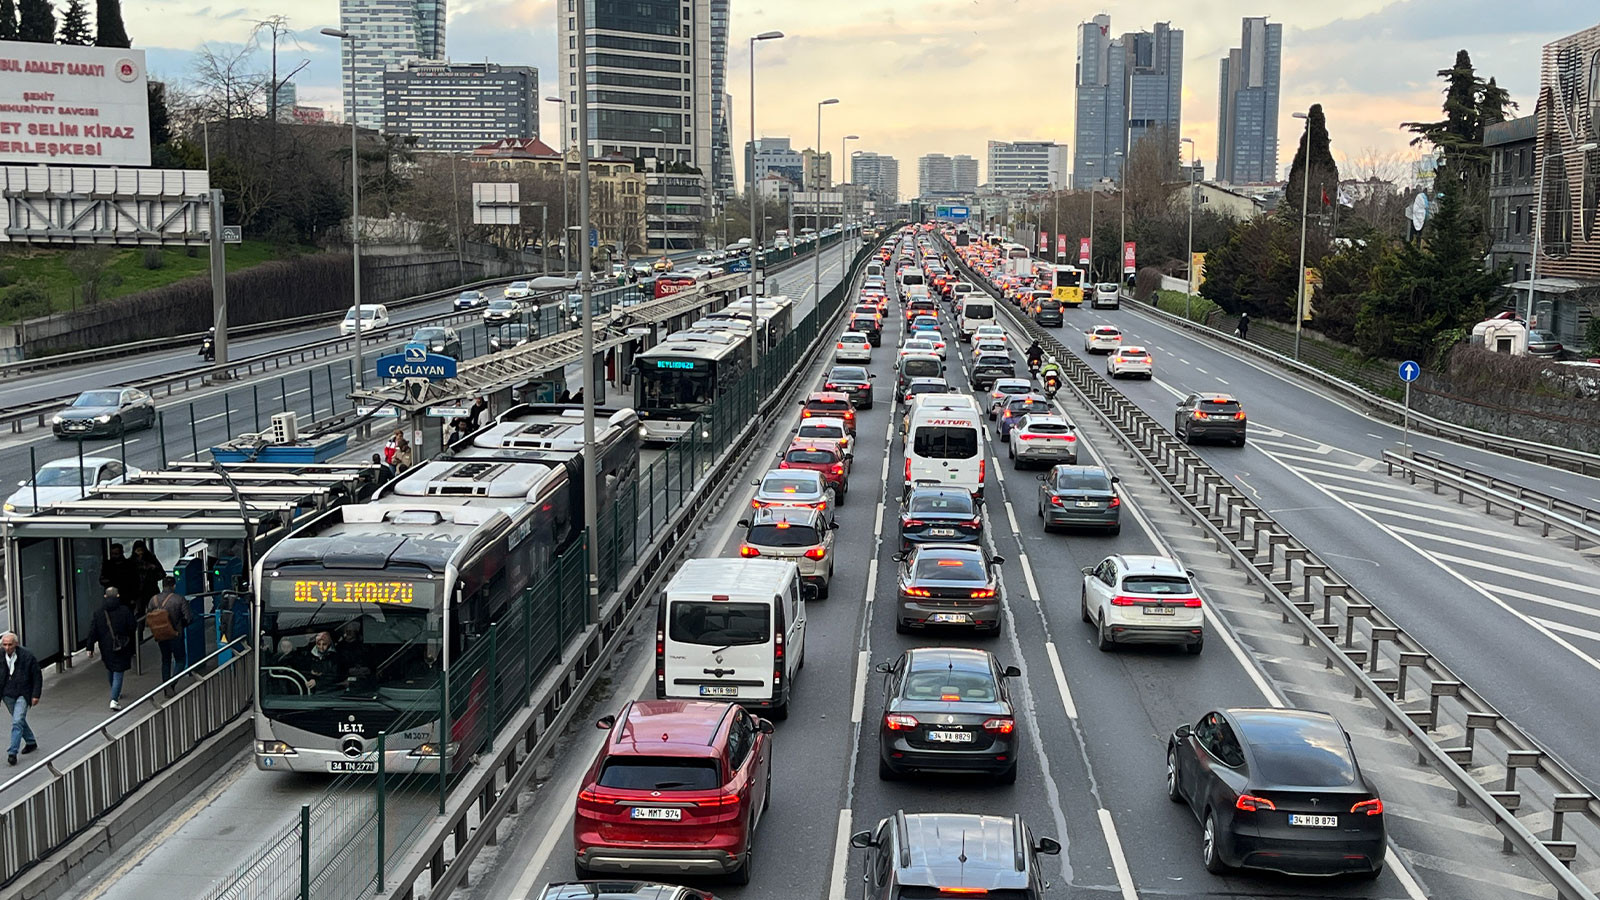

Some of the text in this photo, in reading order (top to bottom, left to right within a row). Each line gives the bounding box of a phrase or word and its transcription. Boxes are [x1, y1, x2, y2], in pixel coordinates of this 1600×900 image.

[25, 60, 65, 75] ADALET
[67, 63, 105, 77] SARAYI
[28, 121, 79, 137] SELİM
[84, 123, 135, 139] KİRAZ
[388, 364, 445, 377] ÇAĞLAYAN
[945, 732, 952, 740] VA
[332, 762, 342, 770] 34
[345, 762, 356, 770] TN
[635, 808, 680, 819] 34 MMT 974
[1293, 816, 1303, 824] 34
[1321, 817, 1336, 826] 879
